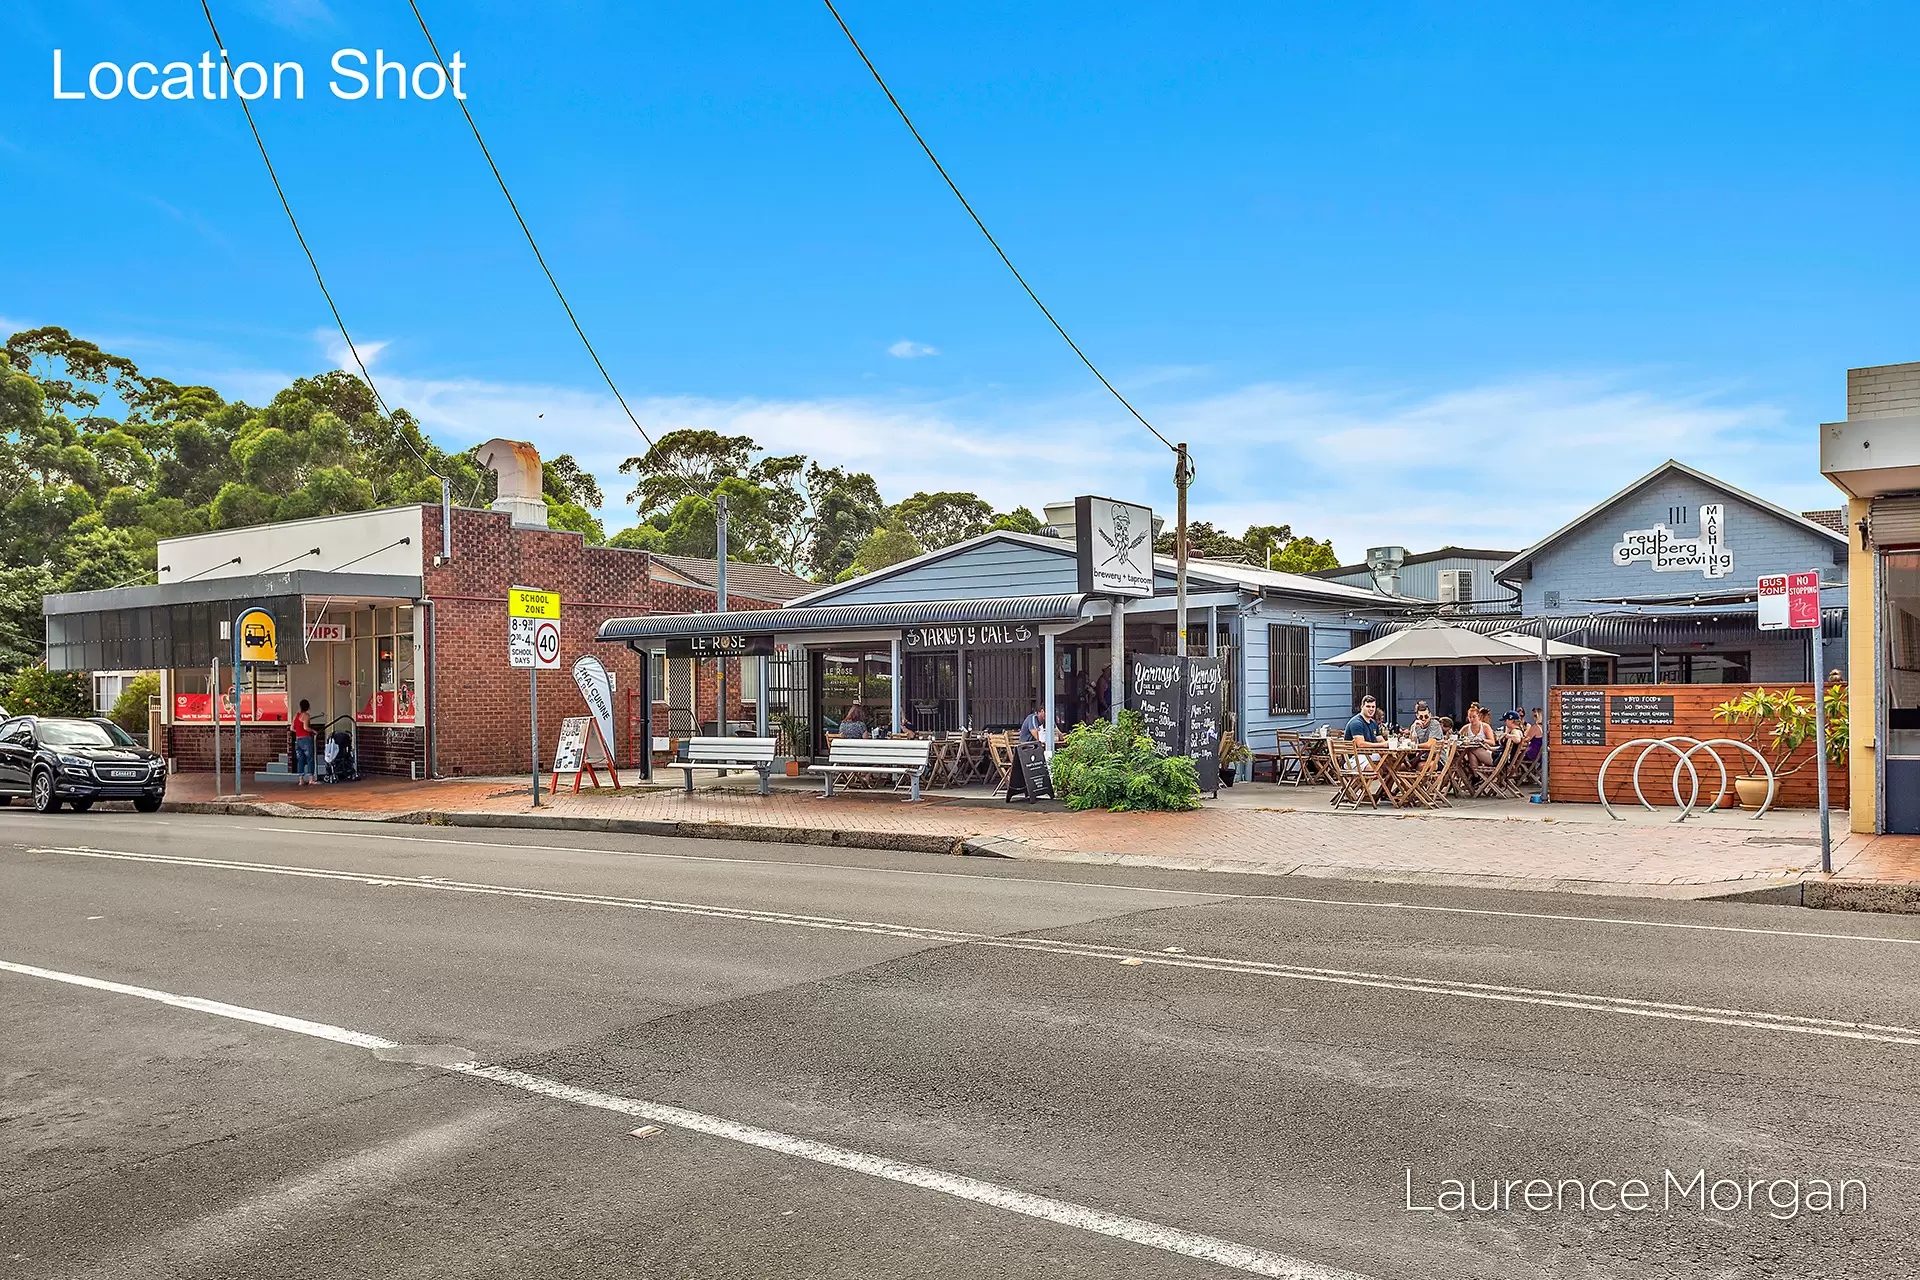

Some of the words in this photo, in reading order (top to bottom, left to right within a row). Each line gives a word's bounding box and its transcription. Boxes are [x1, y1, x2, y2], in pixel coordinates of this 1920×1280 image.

[1706, 505, 1718, 575] MACHINE
[1619, 542, 1697, 560] goldberg
[1093, 567, 1121, 582] brewery
[1128, 574, 1152, 585] taproom
[1796, 576, 1809, 586] NO
[1762, 578, 1783, 587] BUS
[1760, 587, 1786, 595] ZONE
[1789, 586, 1817, 596] STOPPING
[520, 594, 549, 604] SCHOOL
[525, 605, 545, 614] ZONE
[981, 625, 1014, 644] CAFE
[540, 634, 556, 652] 40
[691, 637, 706, 650] LE
[712, 635, 746, 649] ROSE
[511, 648, 533, 656] SCHOOL
[514, 656, 531, 664] DAYS
[825, 667, 834, 675] LE
[1134, 661, 1181, 695] Yarnsy's
[579, 667, 594, 689] THAI
[590, 687, 611, 721] CUISINE
